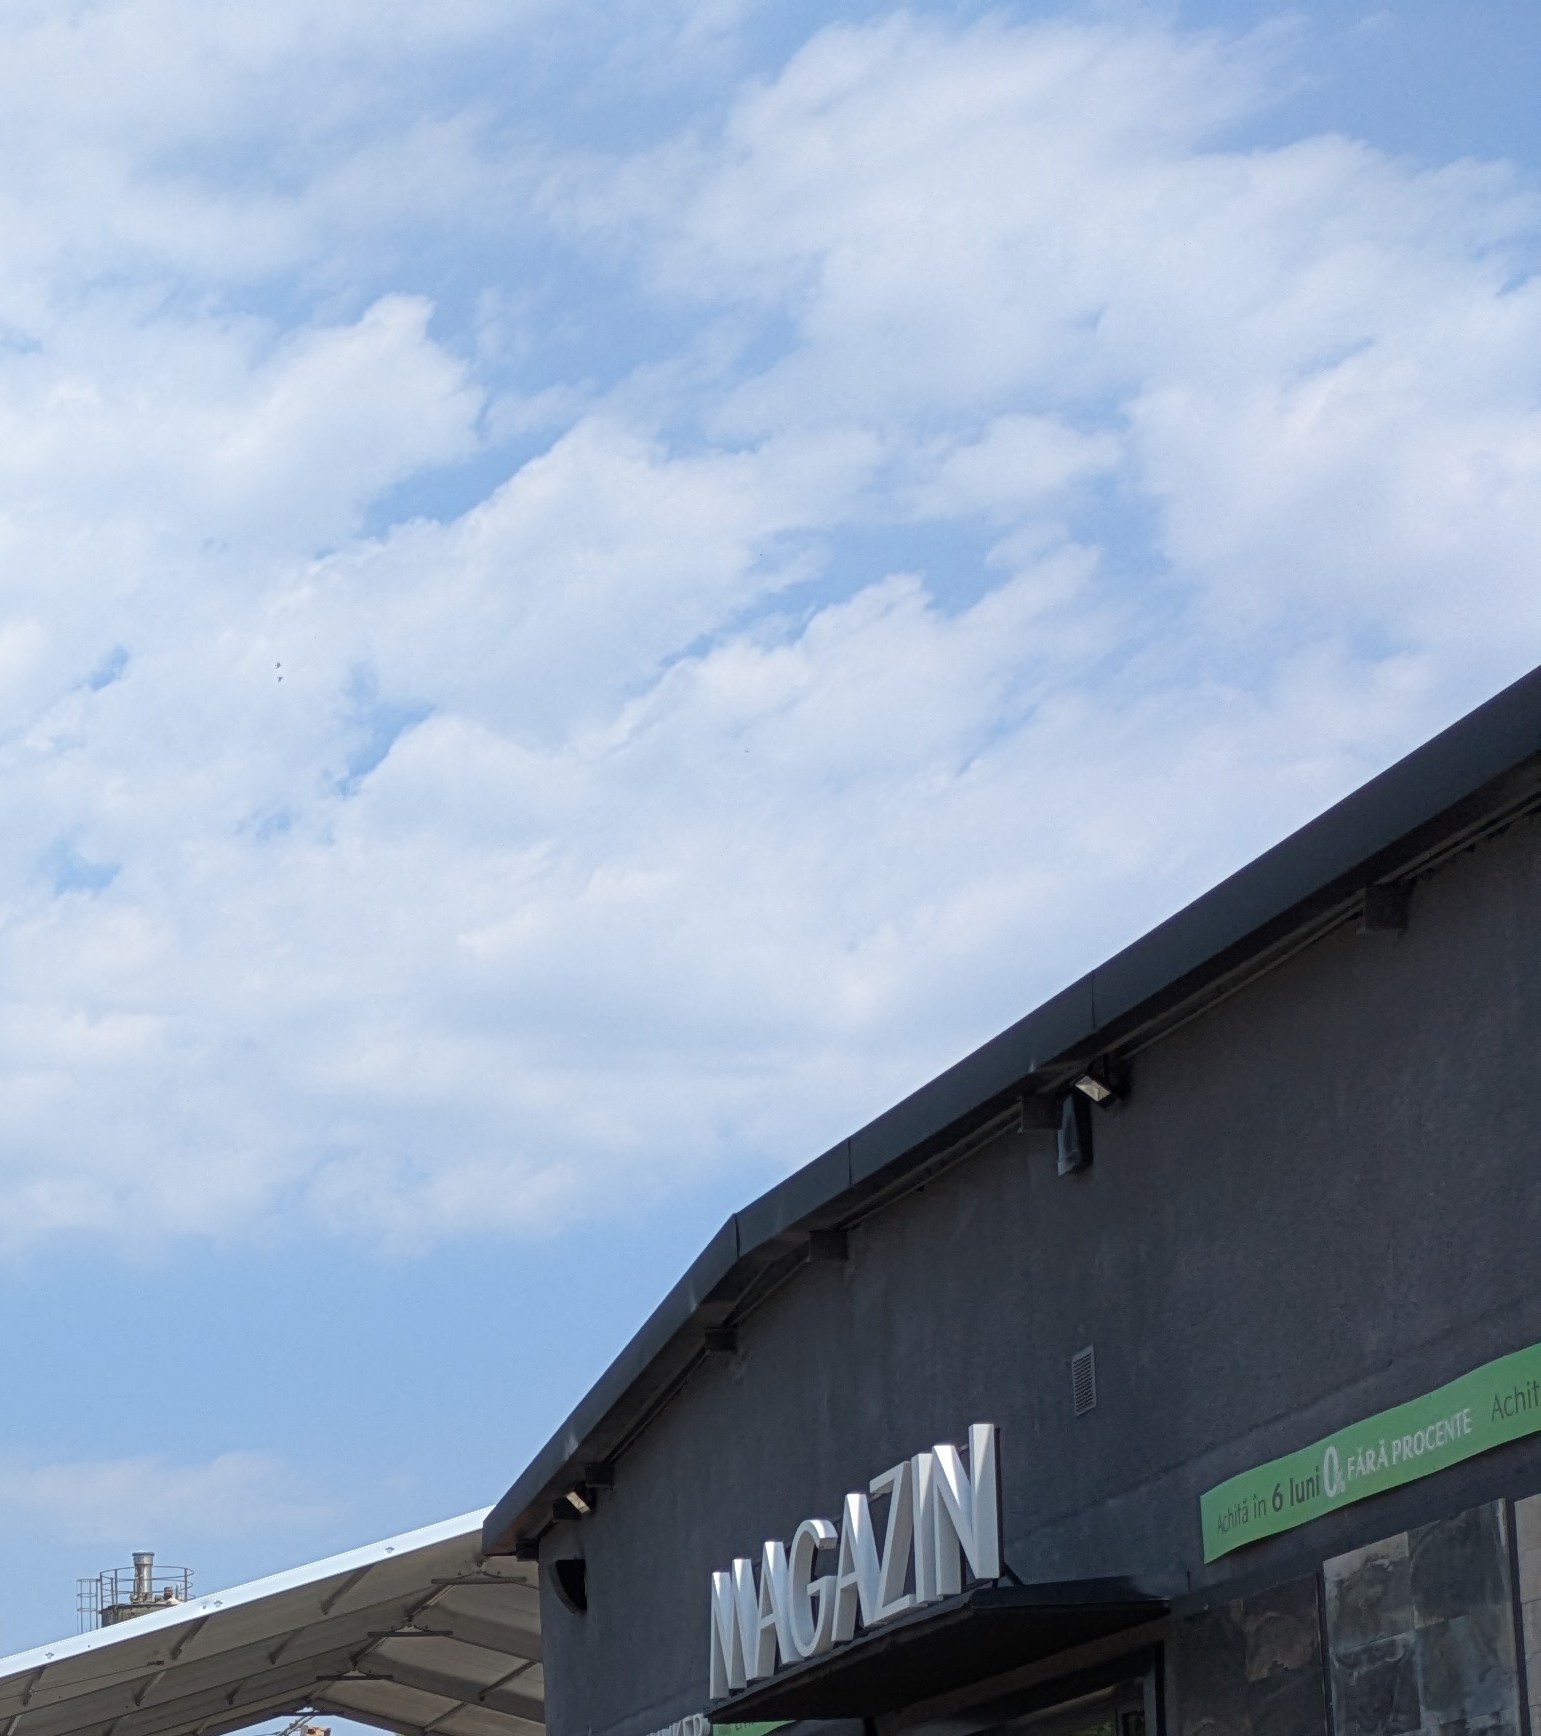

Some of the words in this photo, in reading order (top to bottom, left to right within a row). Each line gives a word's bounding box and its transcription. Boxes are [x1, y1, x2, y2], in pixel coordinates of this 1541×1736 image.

[709, 1422, 1001, 1699] MAGAZIN
[1216, 1498, 1250, 1535] Achită
[1252, 1493, 1268, 1521] în
[1270, 1483, 1284, 1513] 6
[1289, 1465, 1320, 1505] luni
[1346, 1436, 1391, 1481] FĂRĂ
[1390, 1406, 1474, 1466] PROCENTE
